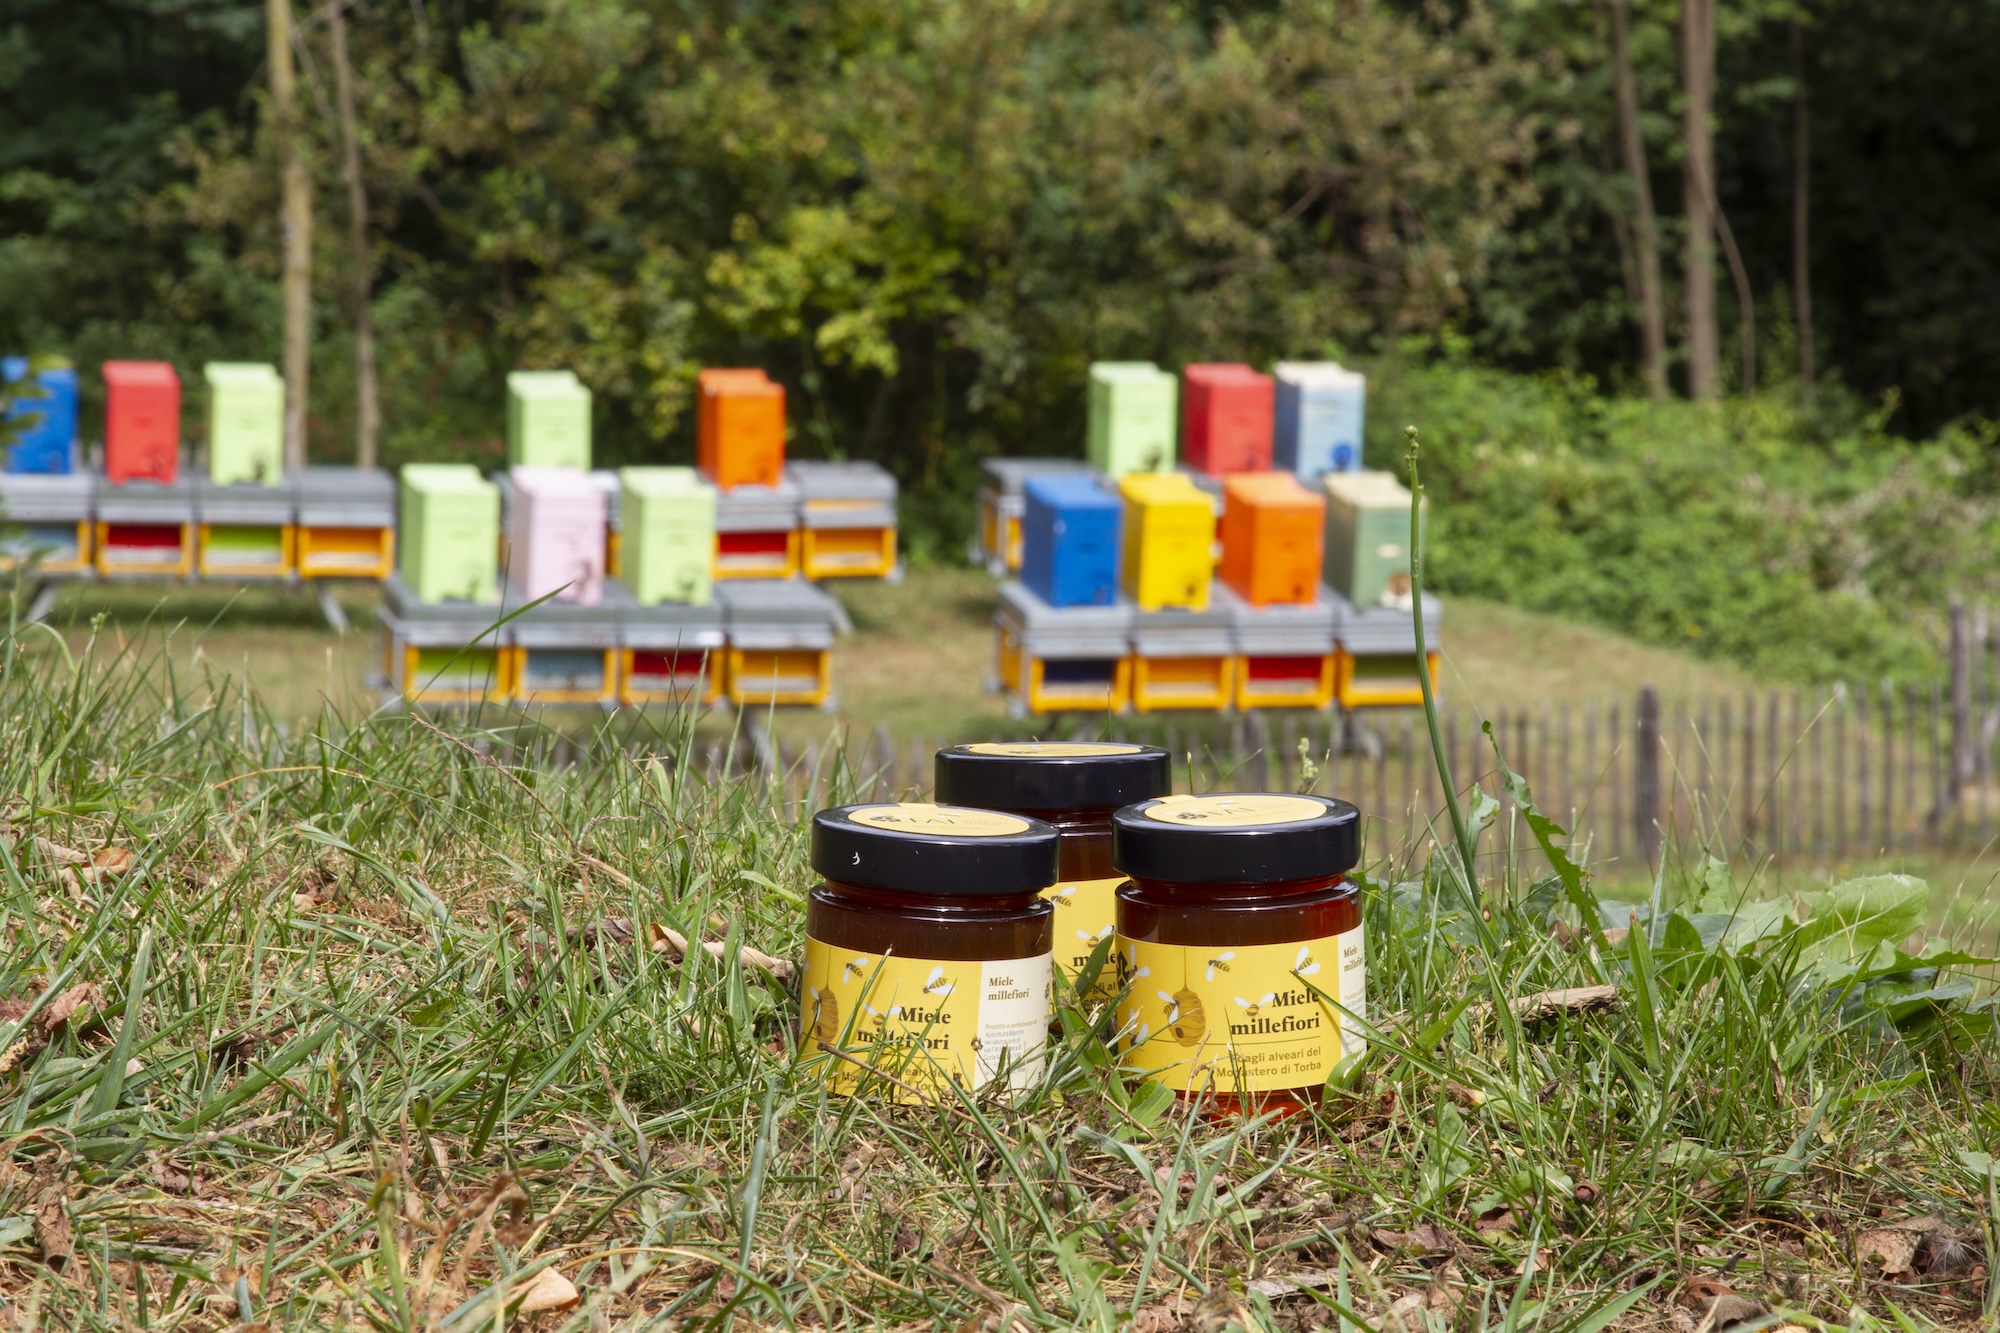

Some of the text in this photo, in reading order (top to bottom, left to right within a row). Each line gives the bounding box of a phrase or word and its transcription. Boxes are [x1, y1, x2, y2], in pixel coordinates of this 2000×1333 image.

[989, 976, 1014, 987] Miele
[988, 987, 1030, 1001] millefiori
[1271, 987, 1320, 1008] Miele
[898, 1006, 951, 1025] Miele
[1230, 1012, 1320, 1035] millefiori
[1268, 1049, 1304, 1062] alveari
[1306, 1046, 1321, 1058] del
[1216, 1060, 1322, 1078] Moastero di Torba
